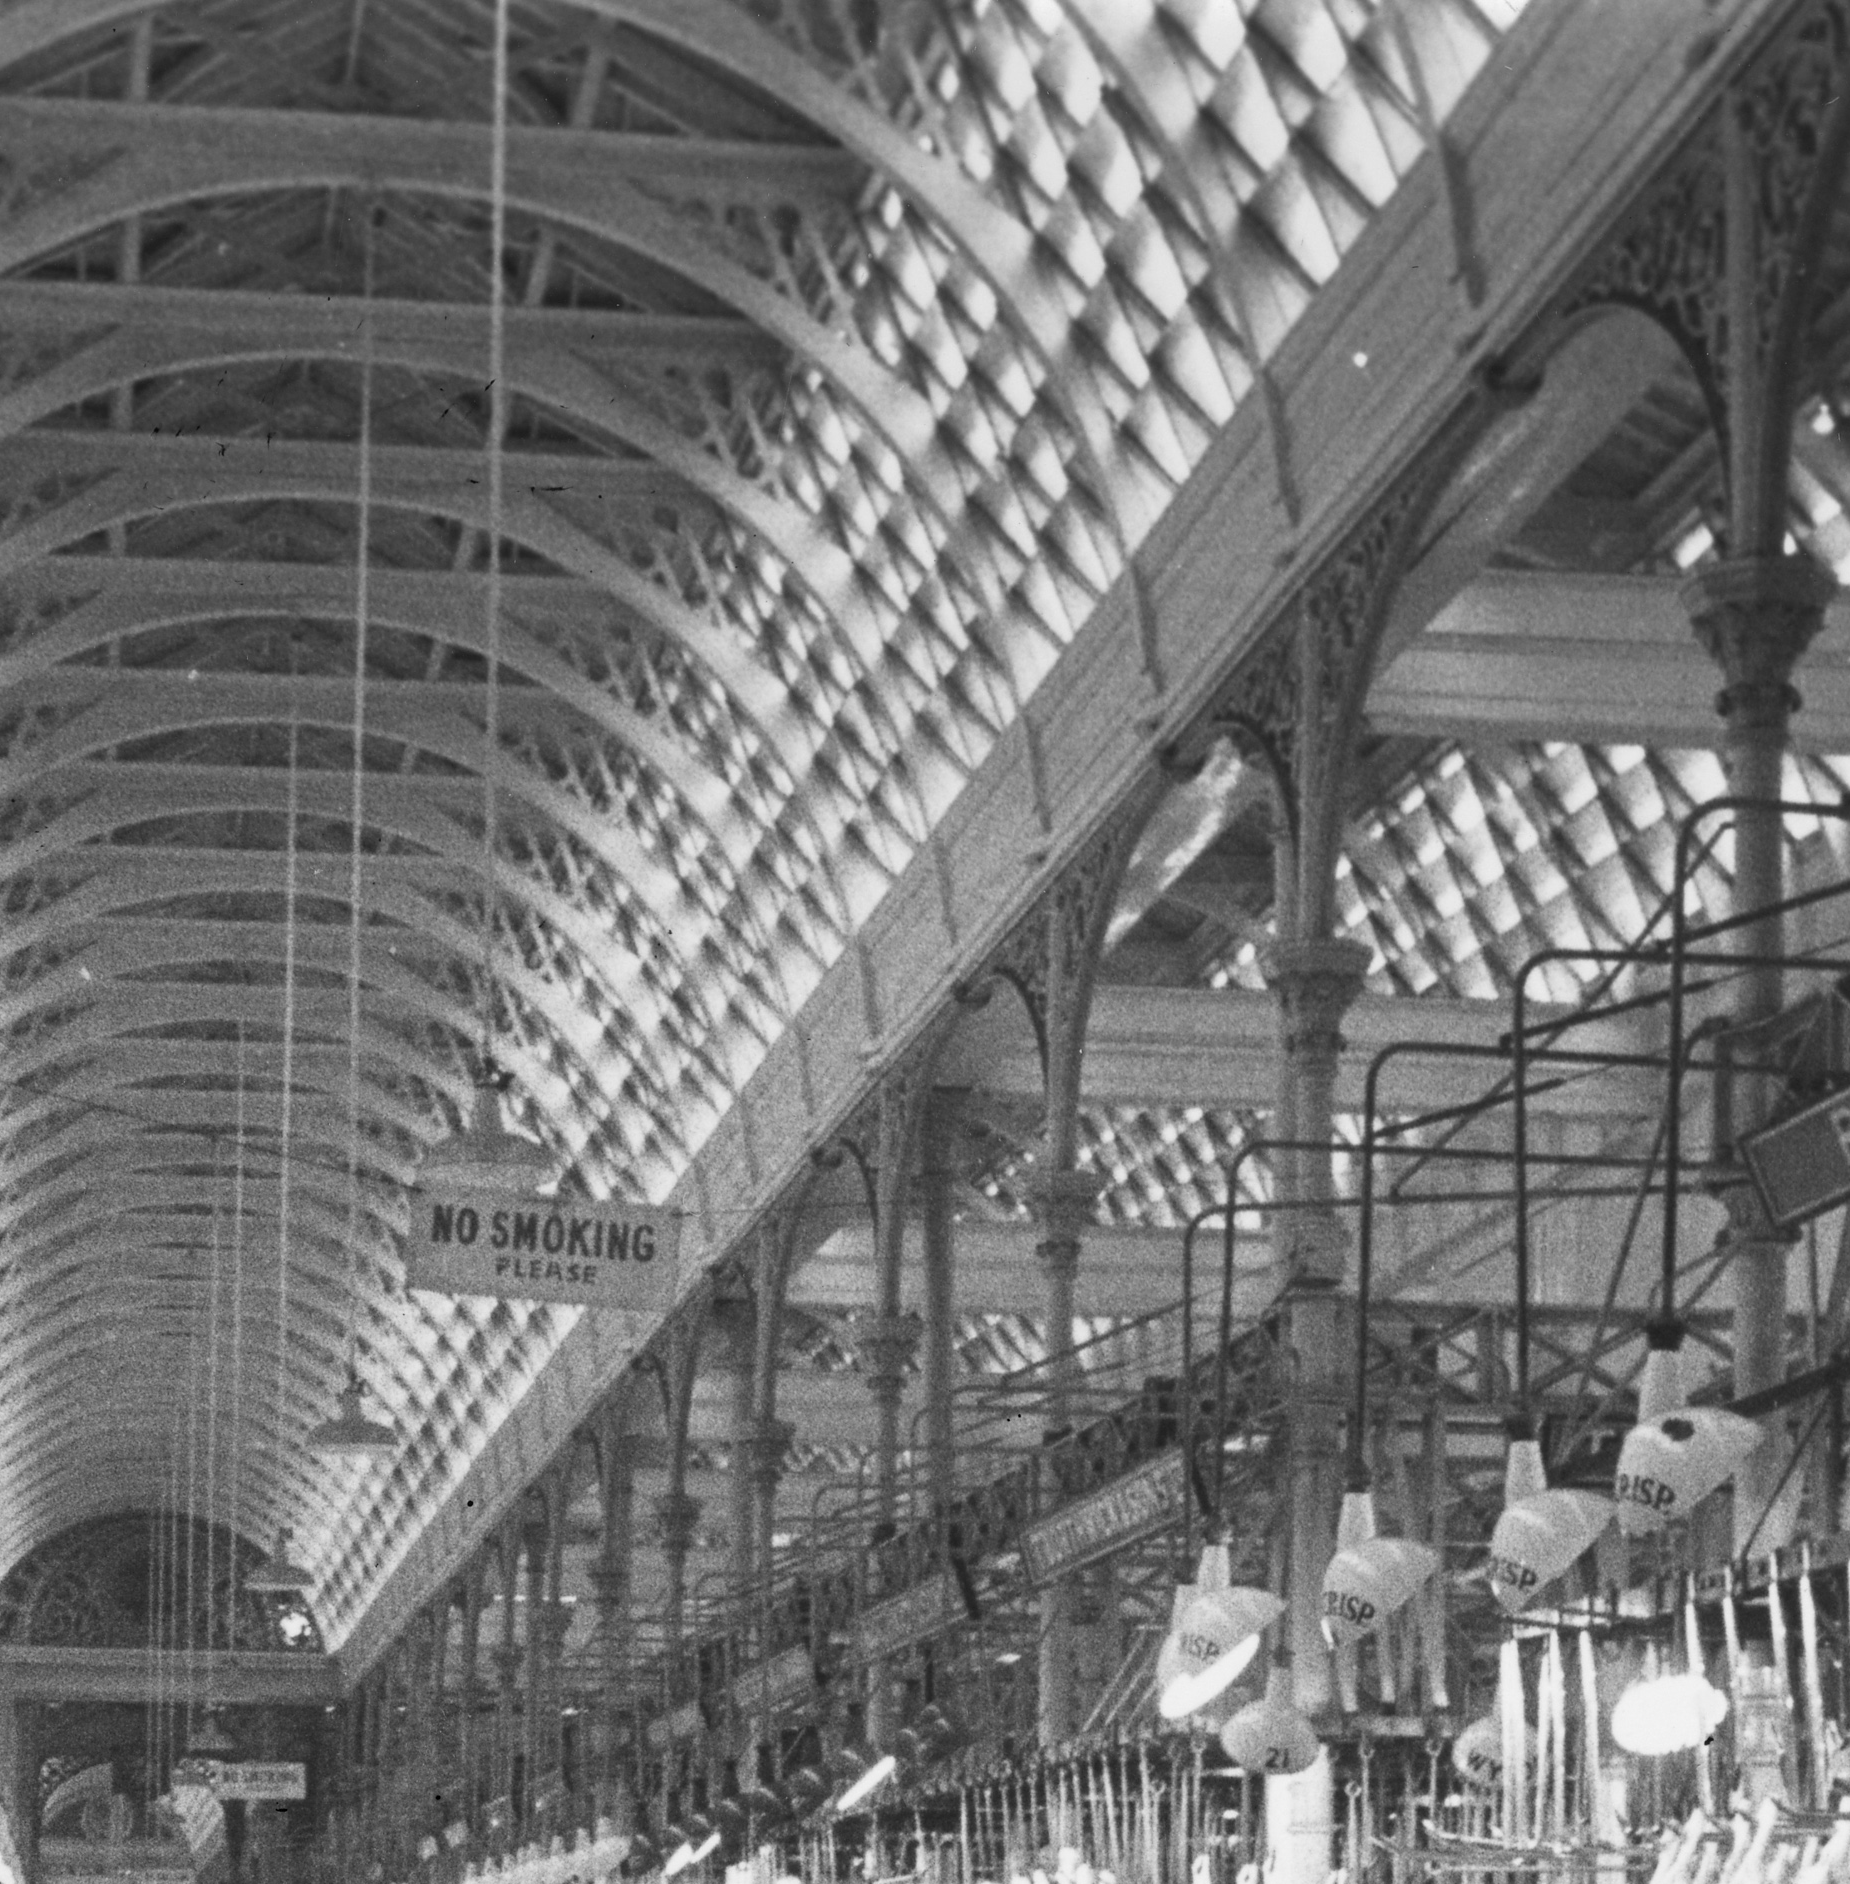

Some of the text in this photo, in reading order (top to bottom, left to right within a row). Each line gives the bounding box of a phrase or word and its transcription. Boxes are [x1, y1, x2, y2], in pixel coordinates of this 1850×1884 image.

[431, 1204, 656, 1263] NO SMOKING
[495, 1255, 599, 1285] PLEASE
[1265, 1746, 1290, 1769] 21
